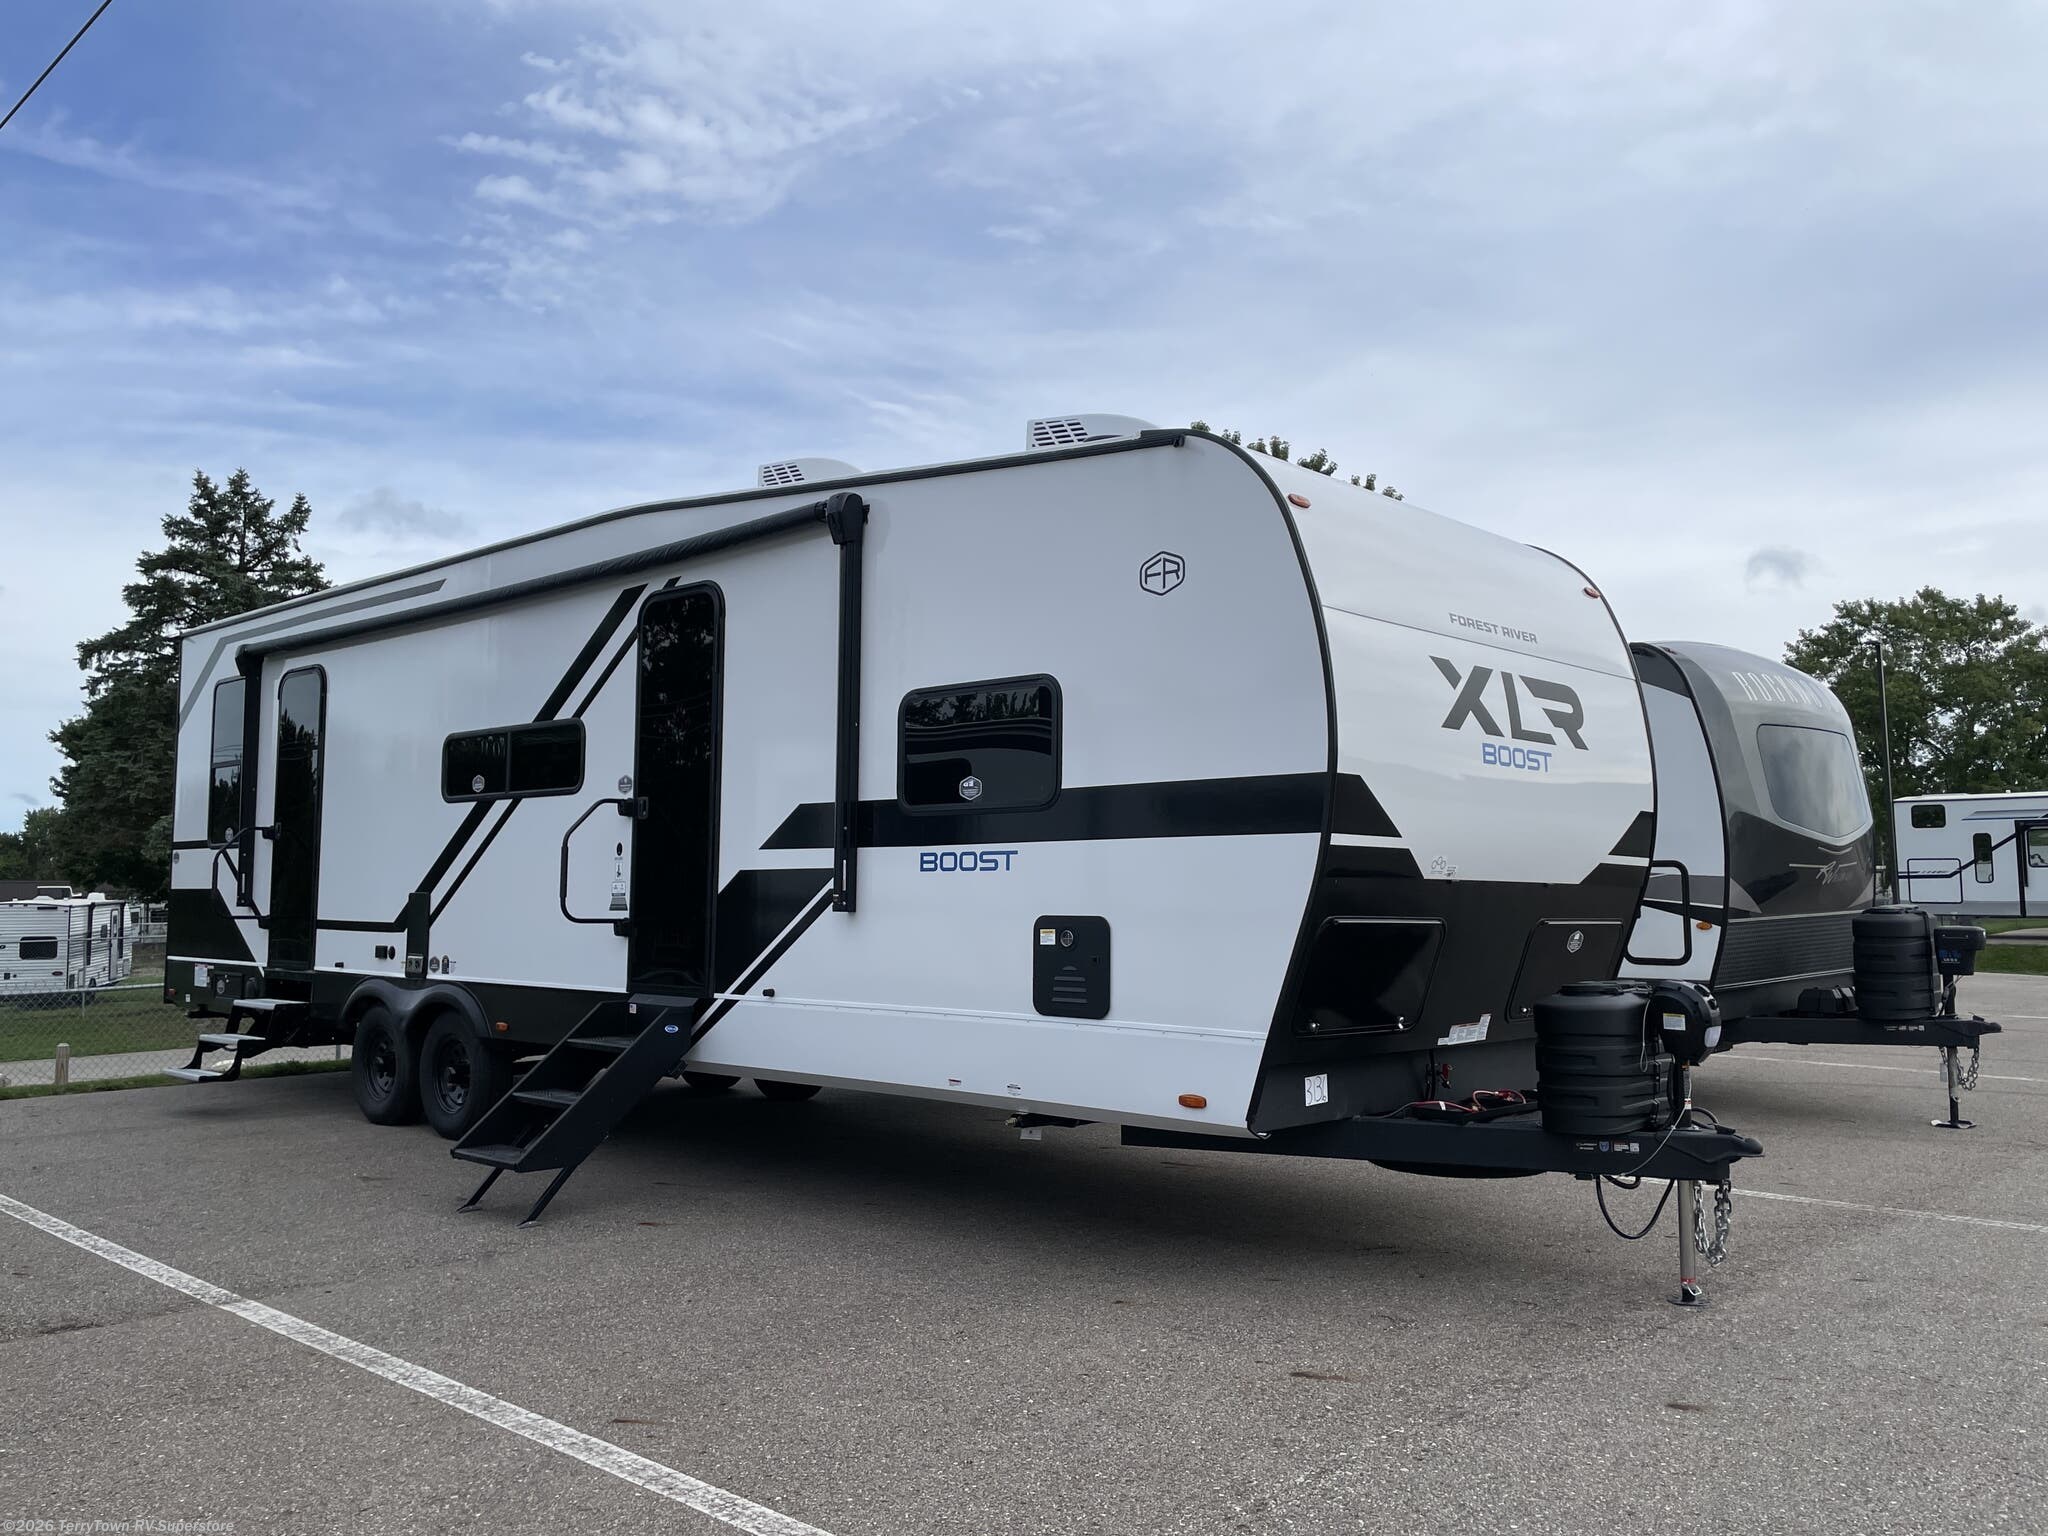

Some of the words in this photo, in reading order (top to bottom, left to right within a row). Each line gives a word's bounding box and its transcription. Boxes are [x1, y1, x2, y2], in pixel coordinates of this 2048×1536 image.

[1449, 612, 1499, 635] FOREST
[1502, 626, 1538, 644] RIVER
[1428, 655, 1590, 751] XLR
[1482, 742, 1553, 773] BOOST
[919, 850, 1018, 872] BOOST
